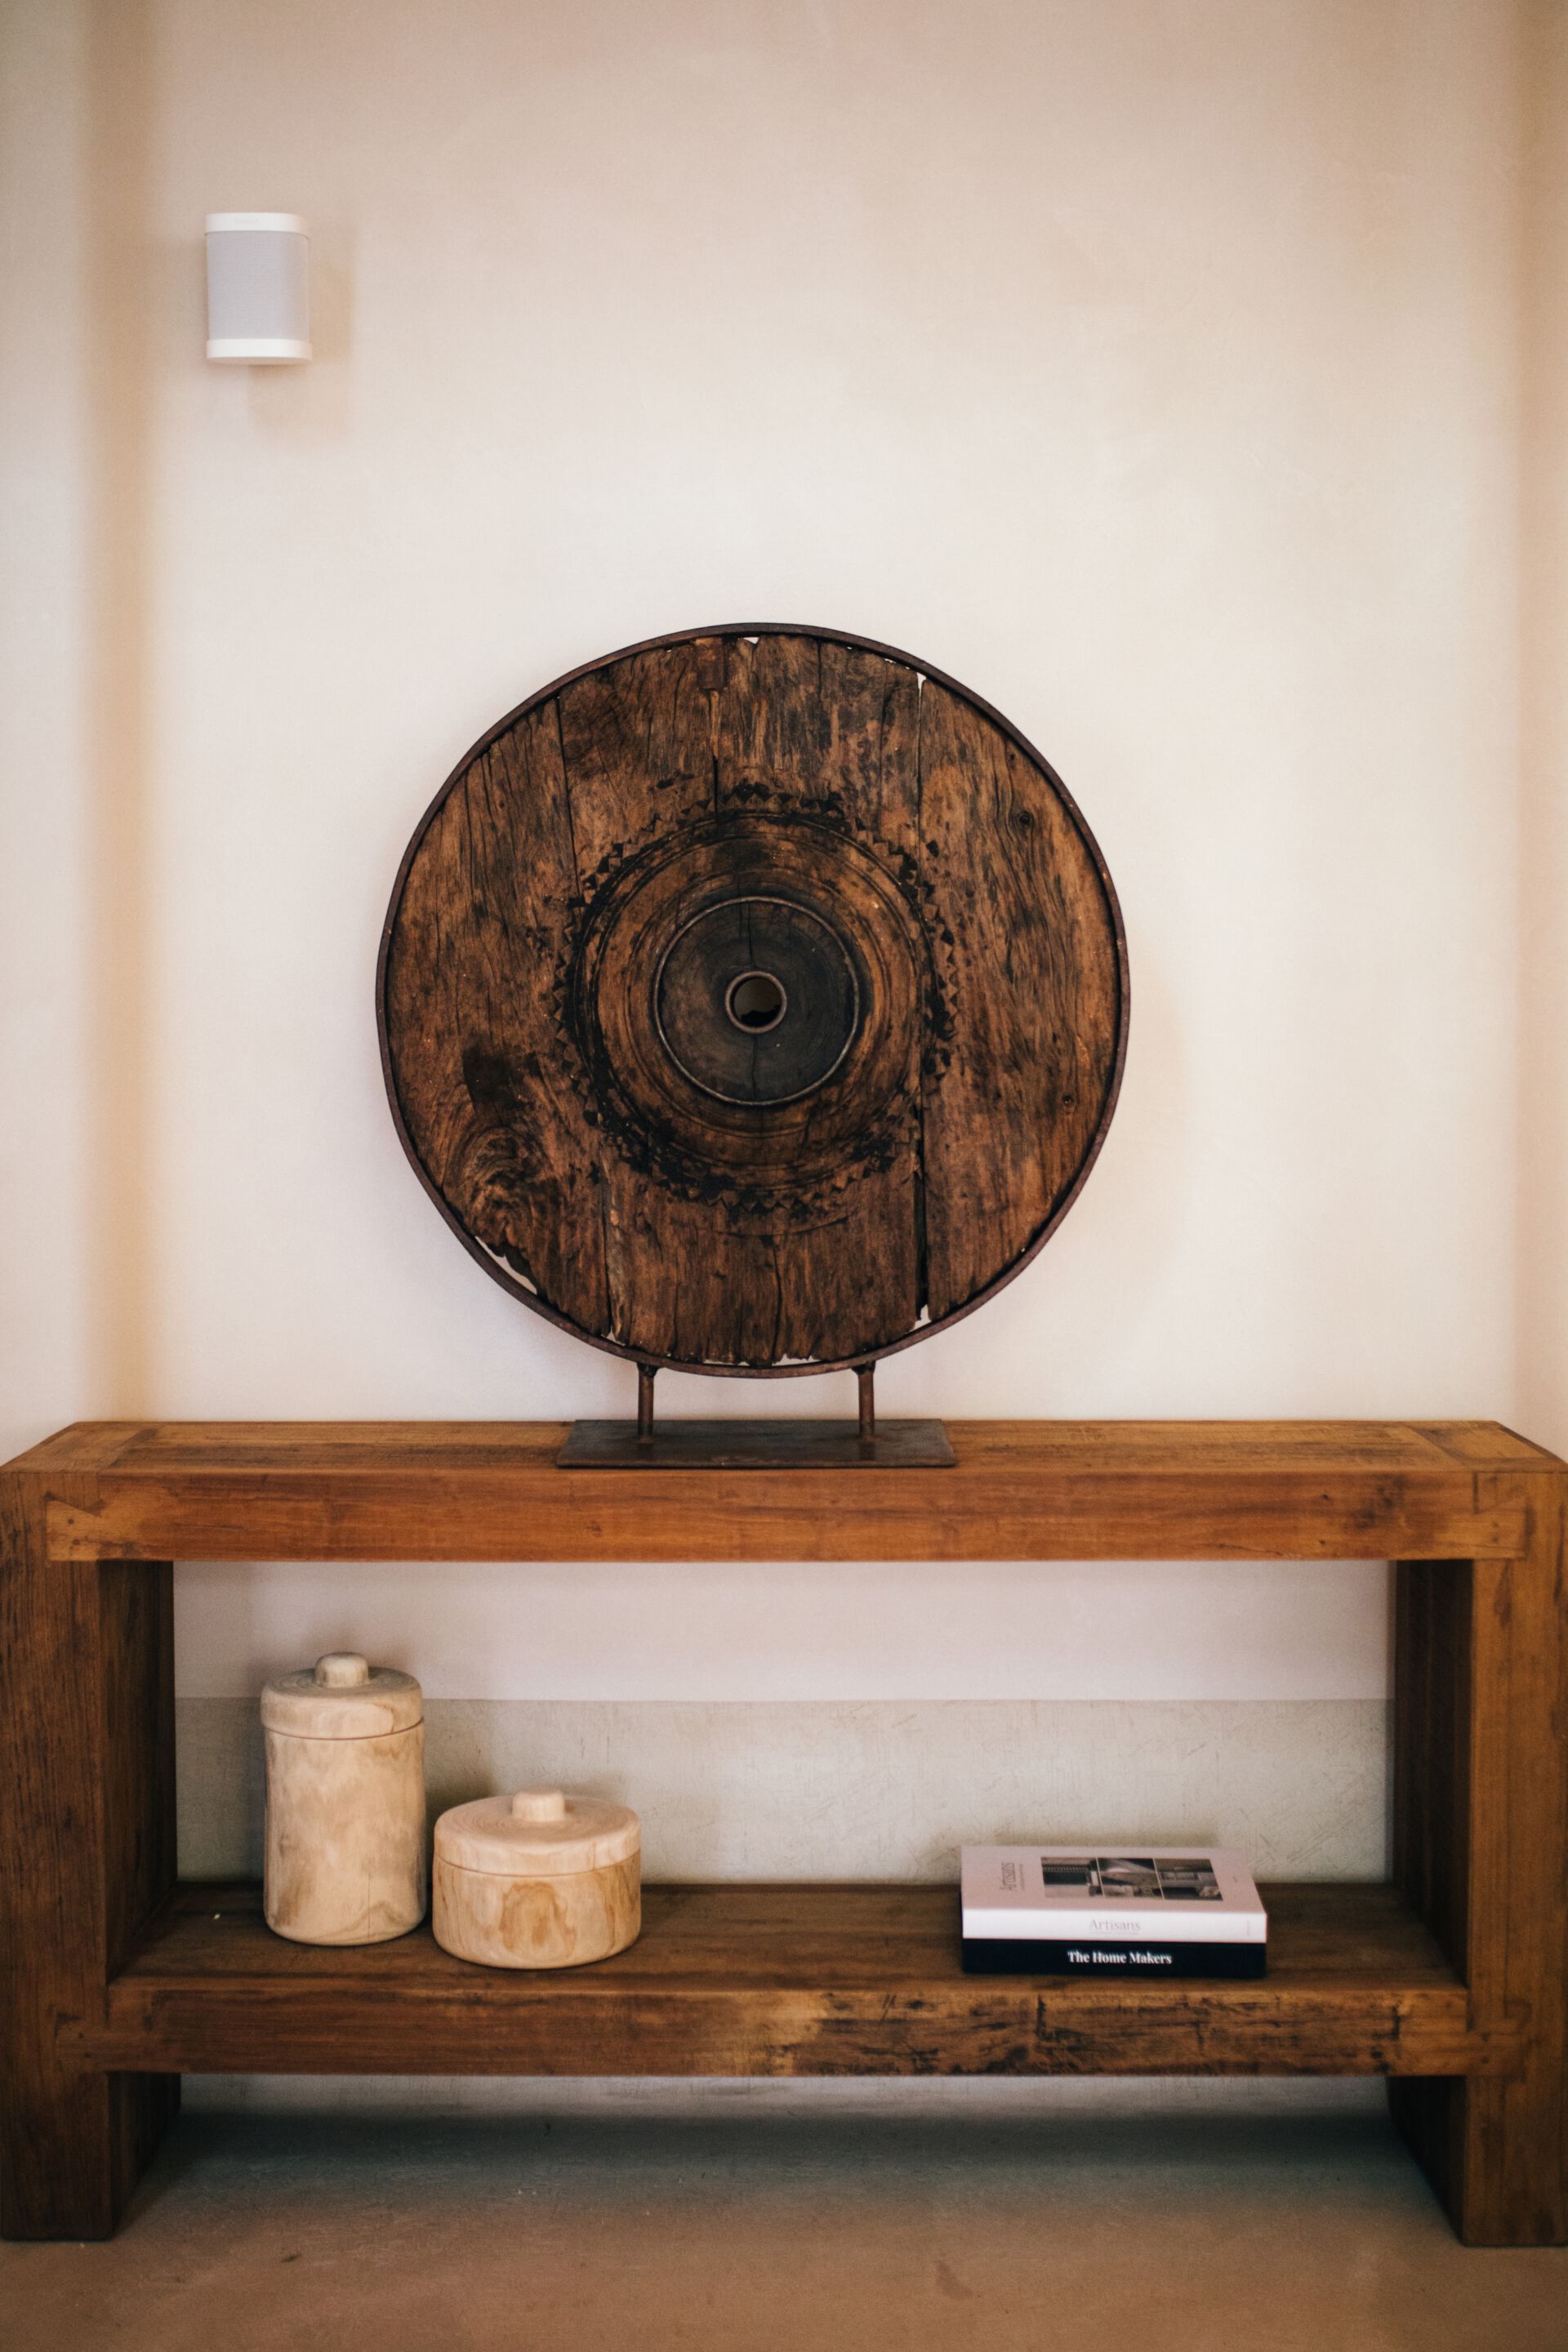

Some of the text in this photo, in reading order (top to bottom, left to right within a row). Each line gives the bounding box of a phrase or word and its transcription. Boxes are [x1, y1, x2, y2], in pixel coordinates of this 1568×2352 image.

[1089, 1918, 1142, 1931] Artisans
[1067, 1950, 1173, 1965] The Home Makers
